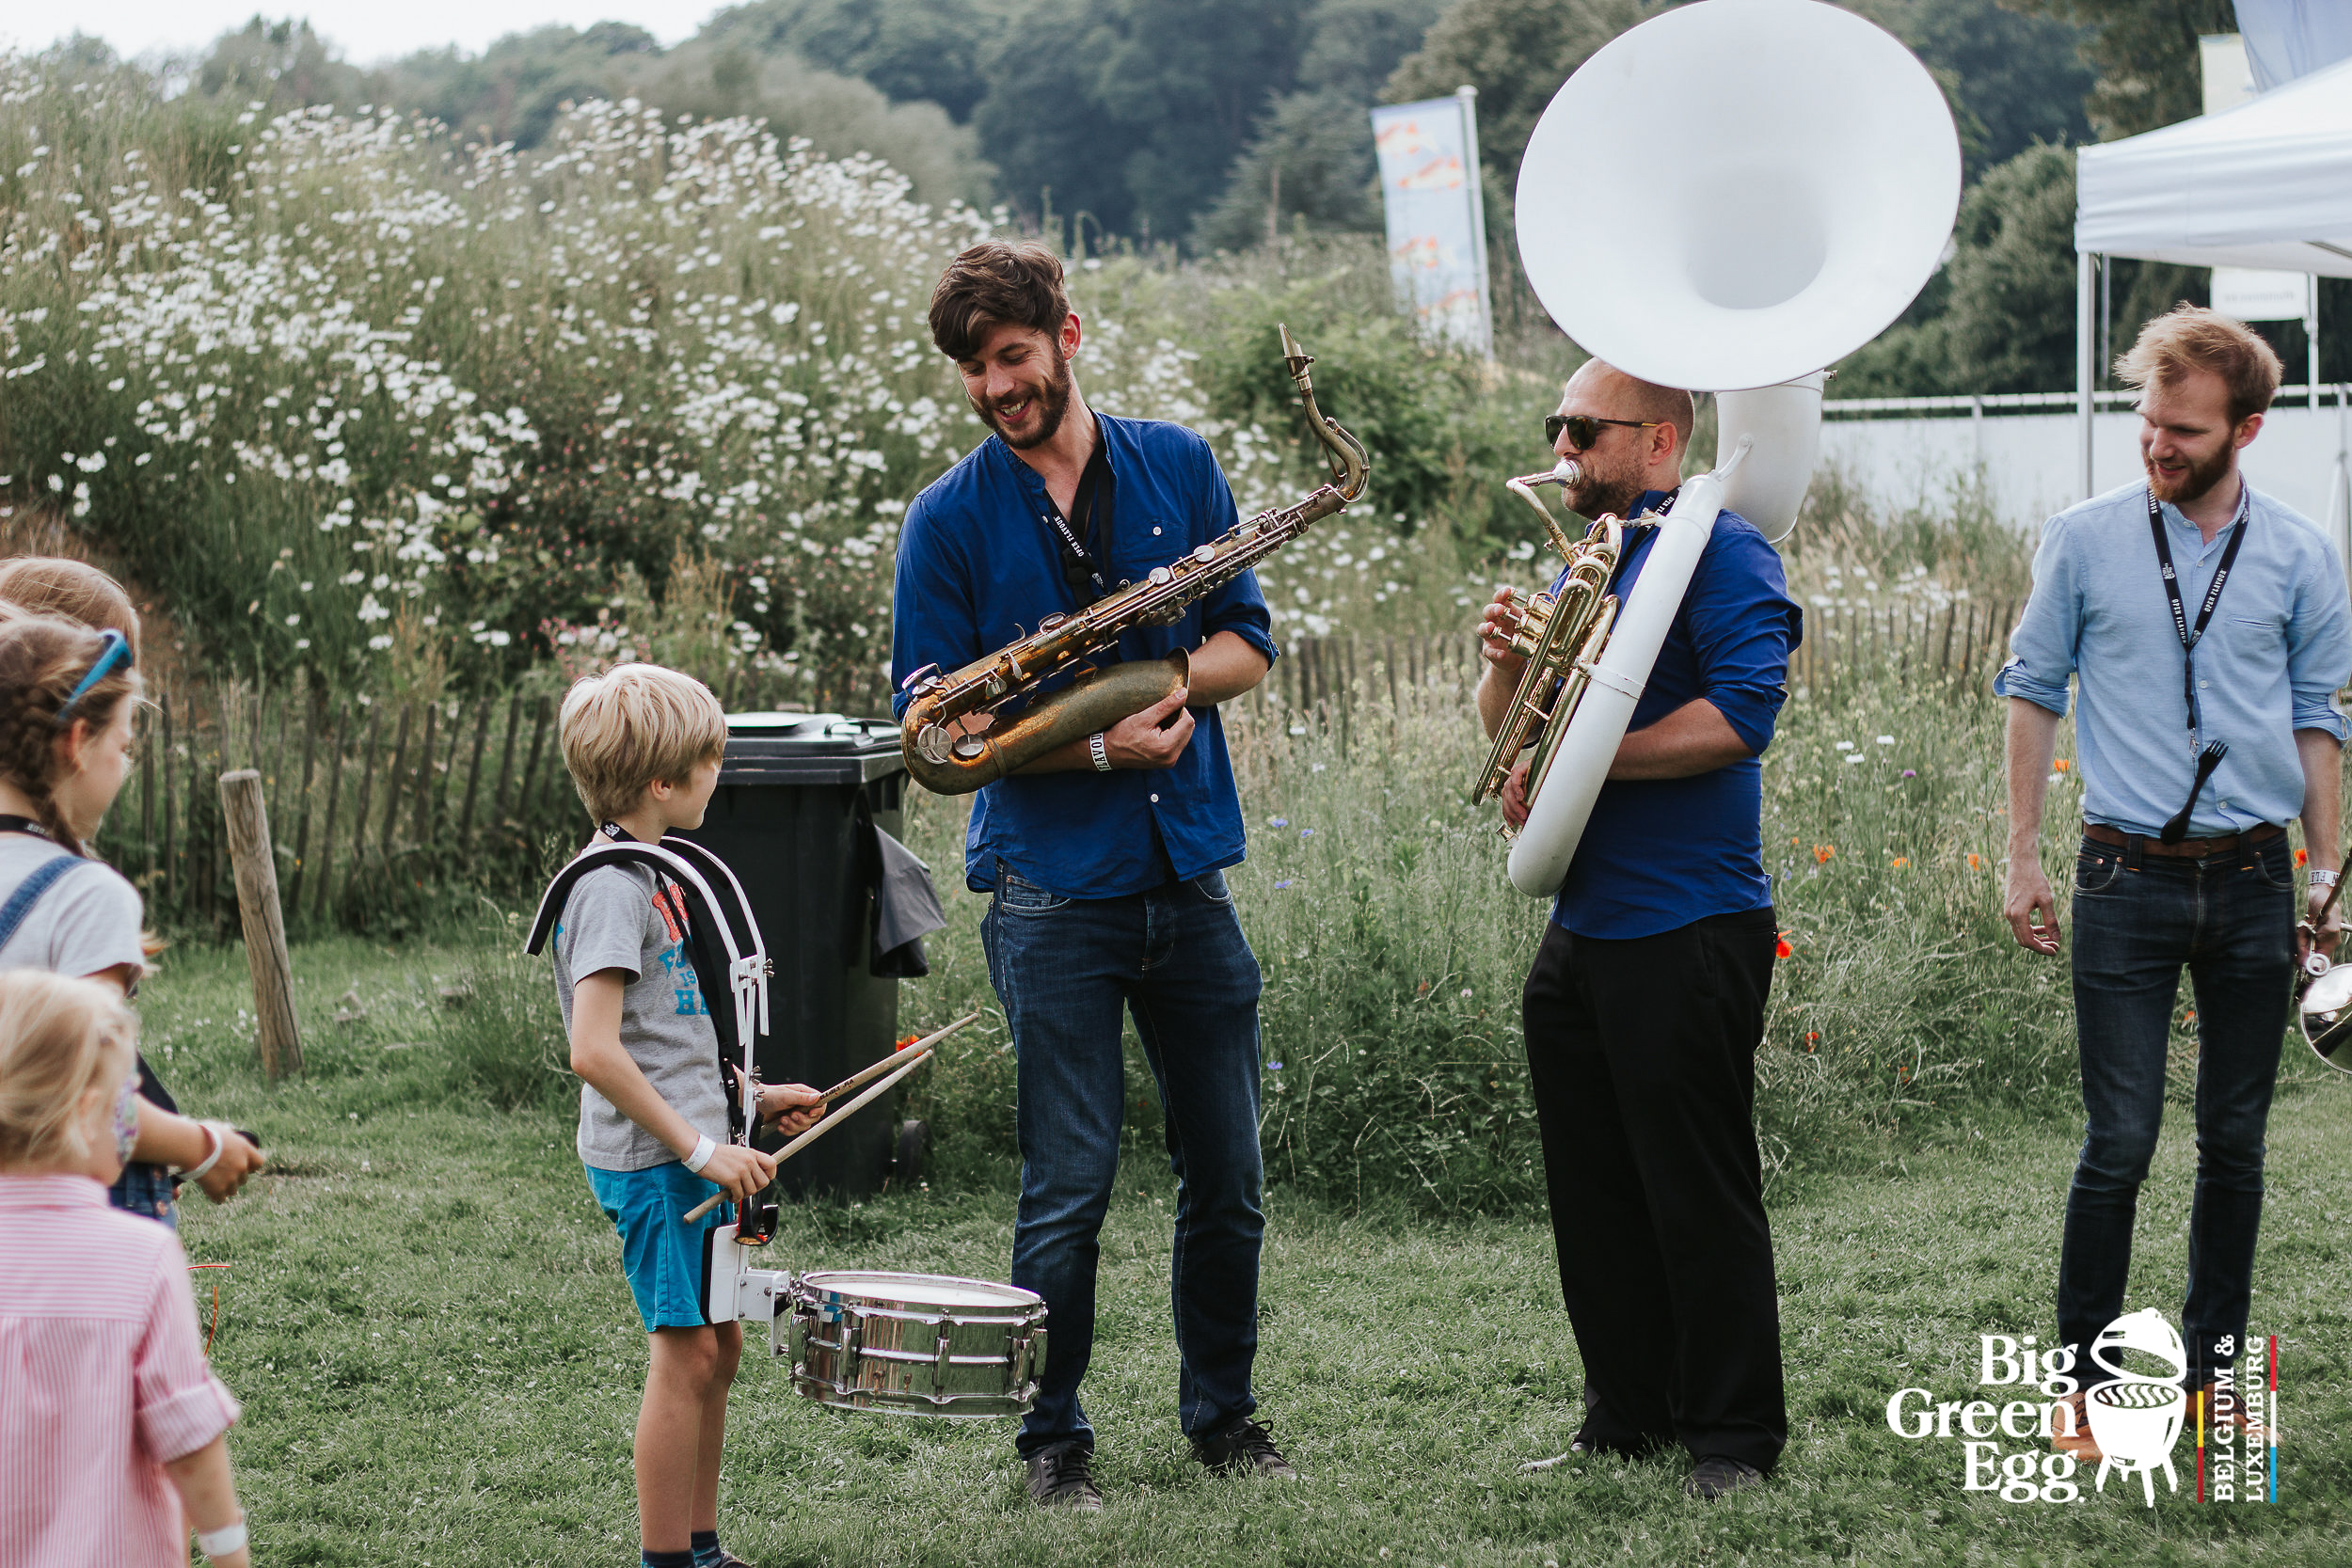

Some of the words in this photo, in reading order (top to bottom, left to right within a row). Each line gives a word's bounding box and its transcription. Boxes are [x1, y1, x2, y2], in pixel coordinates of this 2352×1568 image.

[1054, 515, 1074, 542] FLAVOUR
[1071, 541, 1085, 557] OPEN
[2203, 596, 2216, 612] OPEN
[2210, 569, 2227, 595] FLAVOUR
[2171, 598, 2182, 615] OPEN
[2176, 616, 2186, 643] FLAVOUR
[679, 971, 696, 986] IS
